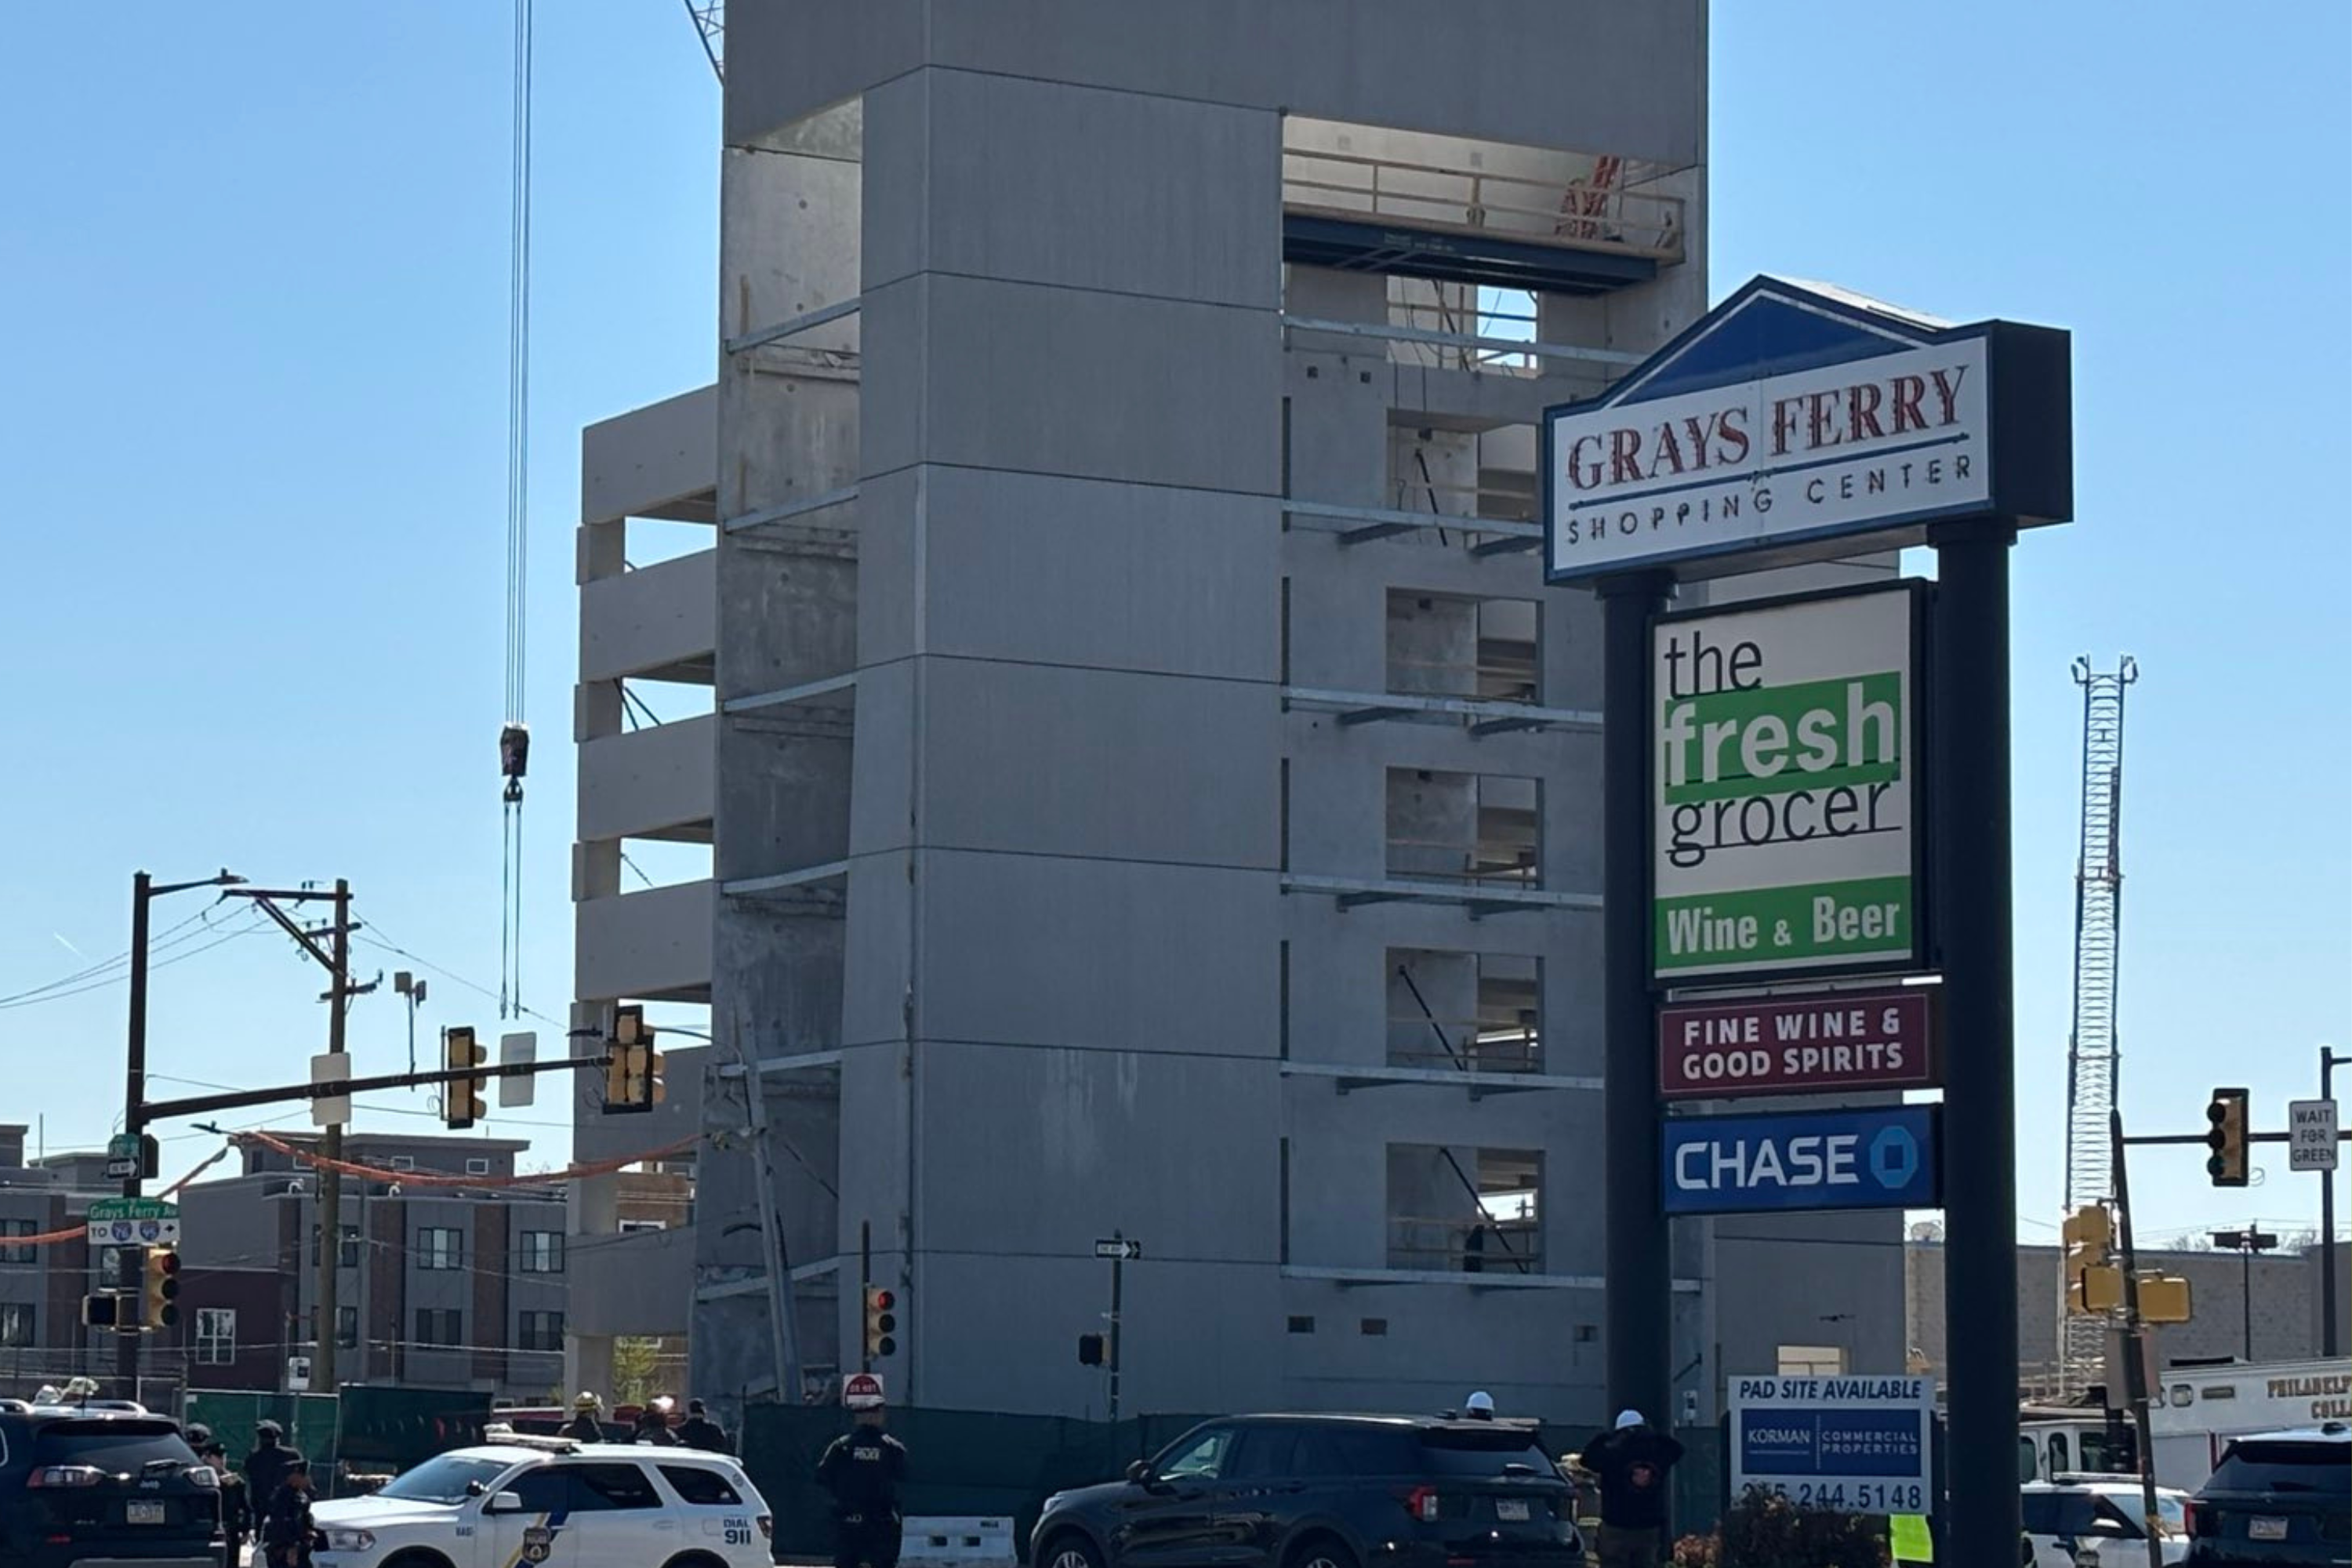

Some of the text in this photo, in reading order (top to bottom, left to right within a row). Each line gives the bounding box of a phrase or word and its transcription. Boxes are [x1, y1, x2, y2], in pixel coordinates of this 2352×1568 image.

[1566, 364, 1970, 492] GRAYS FERRY
[1567, 454, 1973, 546] SHOPPING CENTER
[1664, 630, 1762, 700] the
[1663, 681, 1897, 786] fresh
[1668, 781, 1892, 868] grocer
[1667, 895, 1900, 955] Wine & Beer
[1684, 1007, 1900, 1046] FINE WINE &
[1682, 1042, 1904, 1080] GOOD SPIRITS
[2294, 1109, 2332, 1123] WAIT
[2300, 1129, 2327, 1143] FOR
[1675, 1134, 1860, 1191] CHASE
[2293, 1148, 2336, 1162] GREEN
[90, 1206, 123, 1220] Grays
[129, 1205, 160, 1220] Ferry
[90, 1227, 107, 1238] TO
[1740, 1380, 1922, 1399] PAD SITE AVAILABLE
[2267, 1375, 2352, 1398] PHILADELP
[2311, 1400, 2352, 1420] COLL
[1748, 1429, 1810, 1444] KORMAN
[1822, 1431, 1917, 1442] COMMERCIAL
[1822, 1443, 1918, 1454] PROPERTIES
[1742, 1482, 1922, 1509] 25.244.5148
[724, 1519, 750, 1528] DIAL
[724, 1529, 751, 1544] 911
